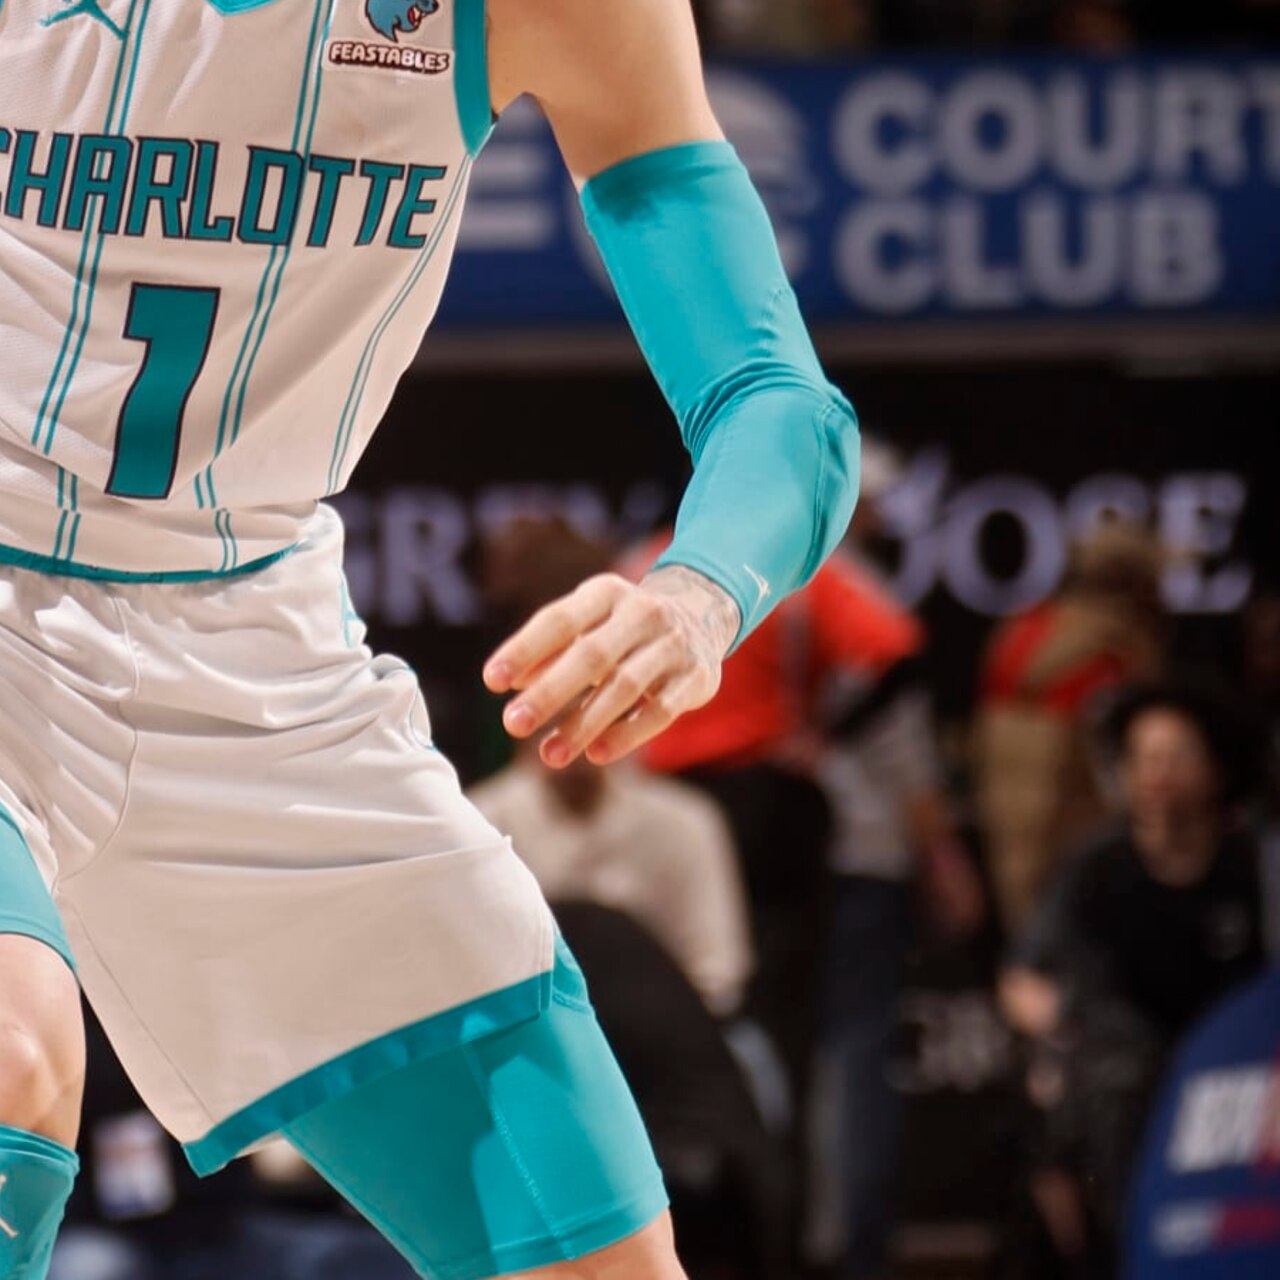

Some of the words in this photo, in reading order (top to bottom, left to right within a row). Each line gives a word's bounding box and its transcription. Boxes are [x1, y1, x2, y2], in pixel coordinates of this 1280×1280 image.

[329, 42, 450, 75] FEASTABLES
[833, 190, 1220, 312] CLUB
[104, 282, 221, 500] 1
